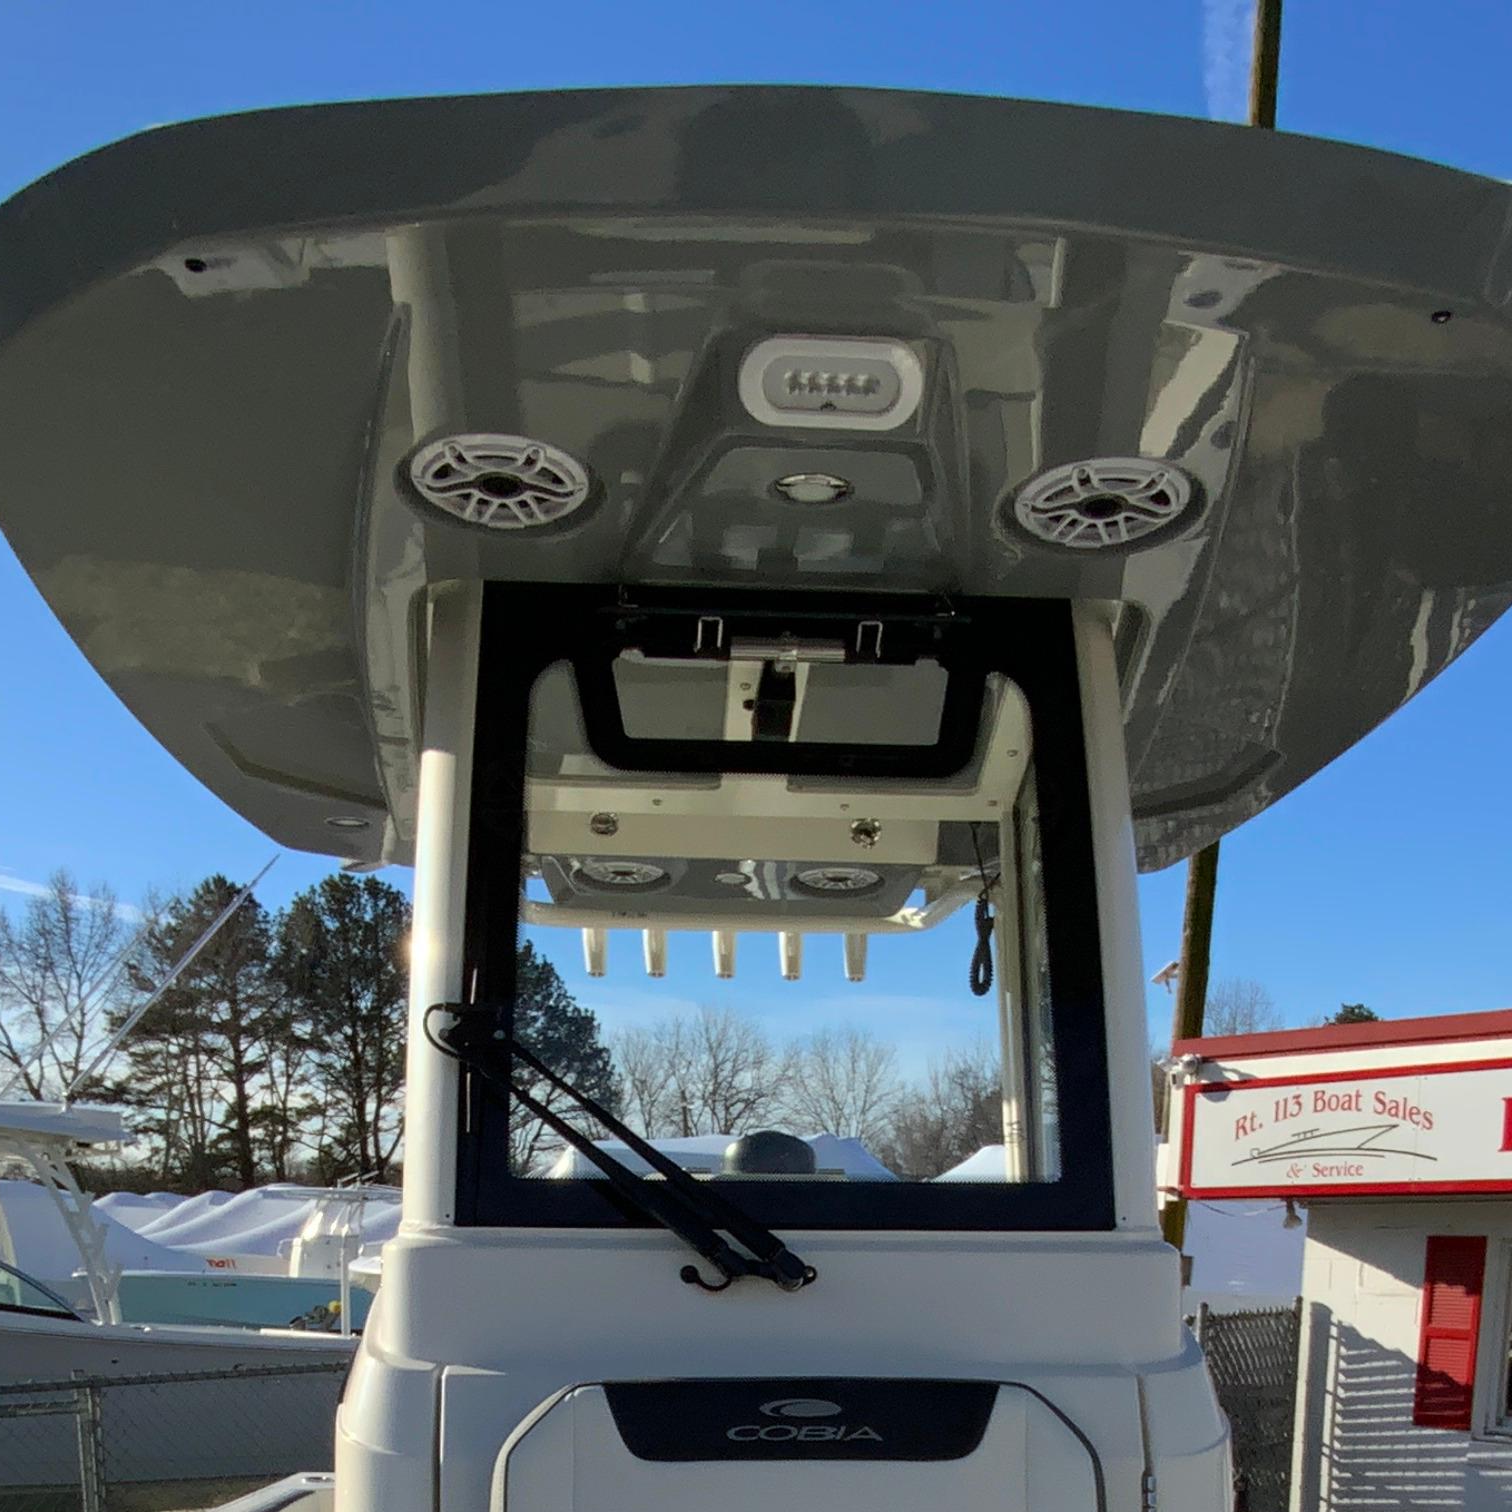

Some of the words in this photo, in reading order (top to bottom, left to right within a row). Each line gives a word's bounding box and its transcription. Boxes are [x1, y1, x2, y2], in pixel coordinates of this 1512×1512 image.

[1234, 1111, 1264, 1142] Rt.
[1273, 1094, 1303, 1123] 113
[1312, 1089, 1363, 1114] Boat
[1373, 1090, 1434, 1131] Sales
[1286, 1162, 1304, 1179] &
[1312, 1161, 1364, 1178] Service
[725, 1424, 885, 1442] COBIA
